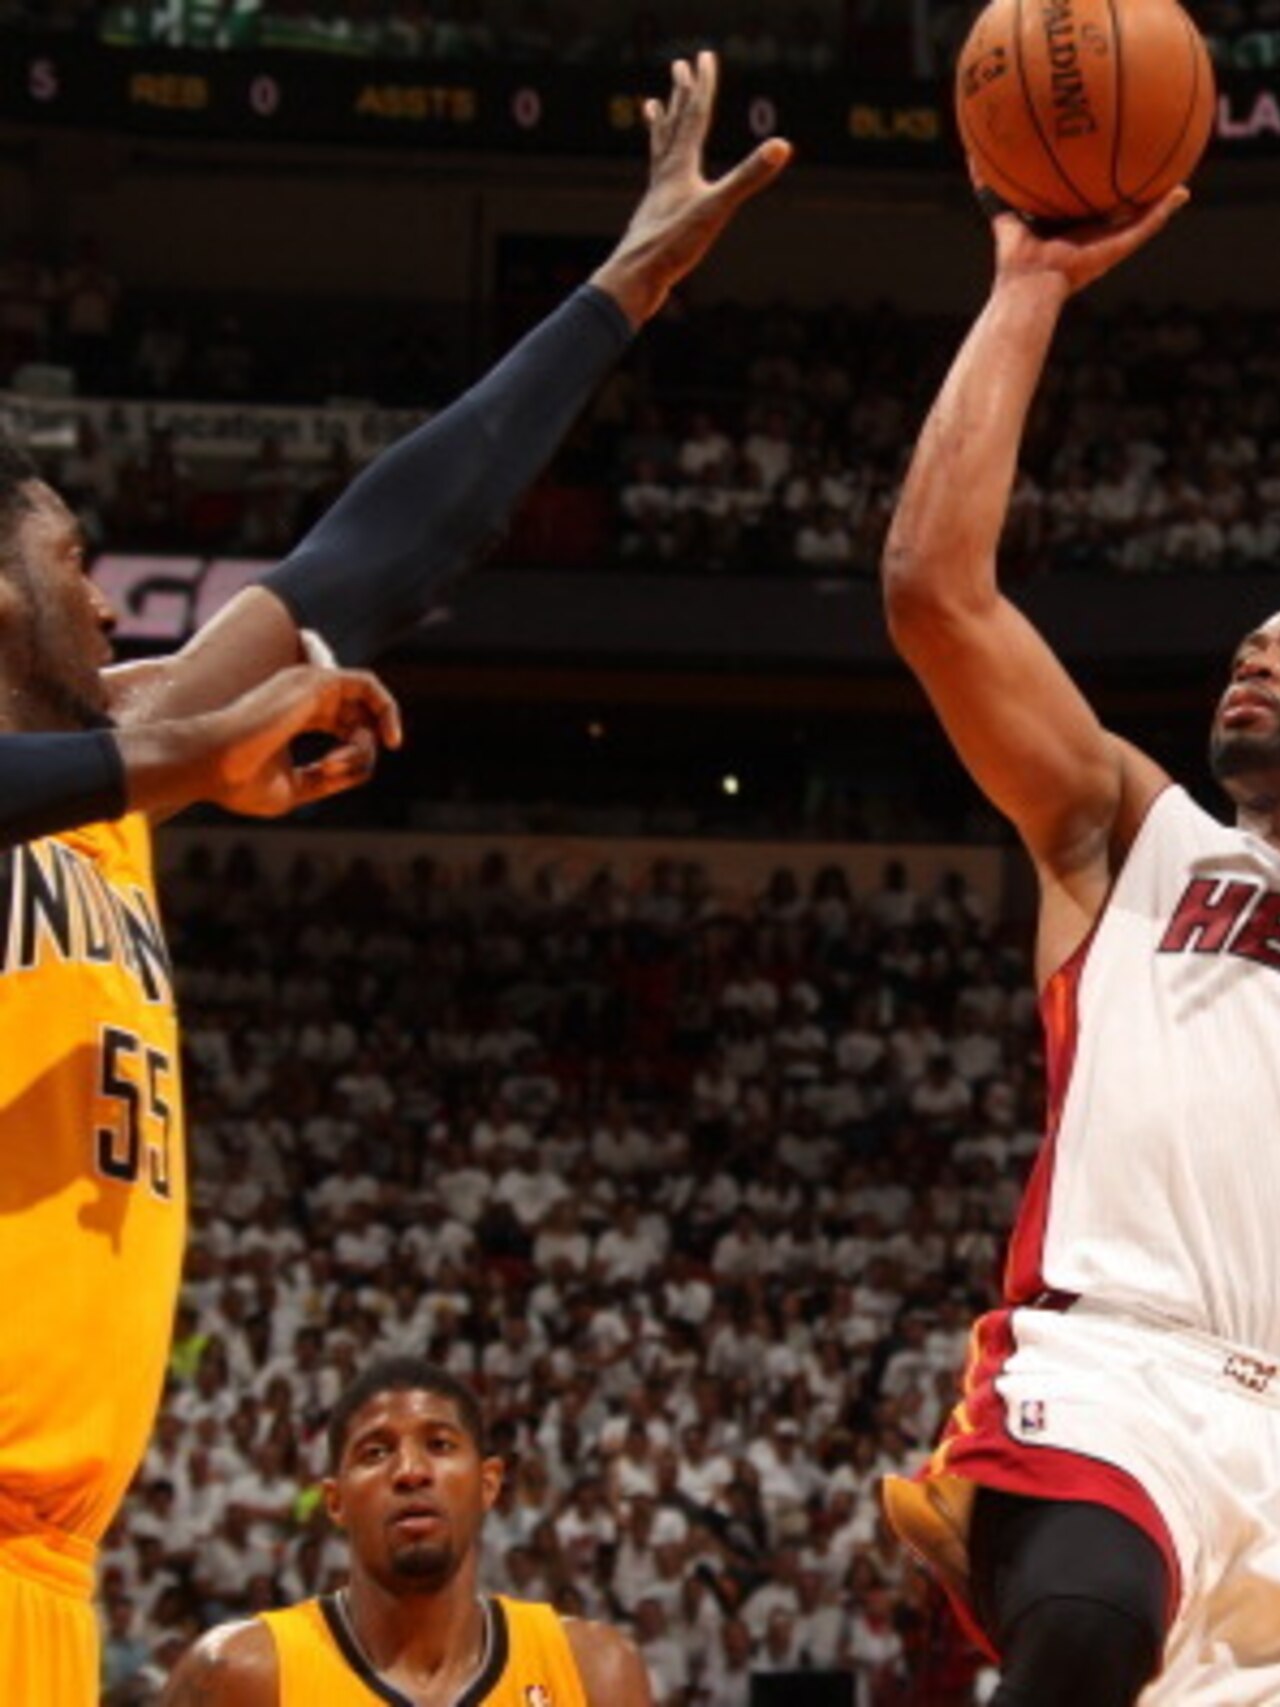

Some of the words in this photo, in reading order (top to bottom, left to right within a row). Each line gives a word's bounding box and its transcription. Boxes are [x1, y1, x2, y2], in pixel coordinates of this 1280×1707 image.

[127, 71, 210, 111] REB
[1042, 0, 1099, 137] ALDING
[96, 1024, 171, 1200] 55
